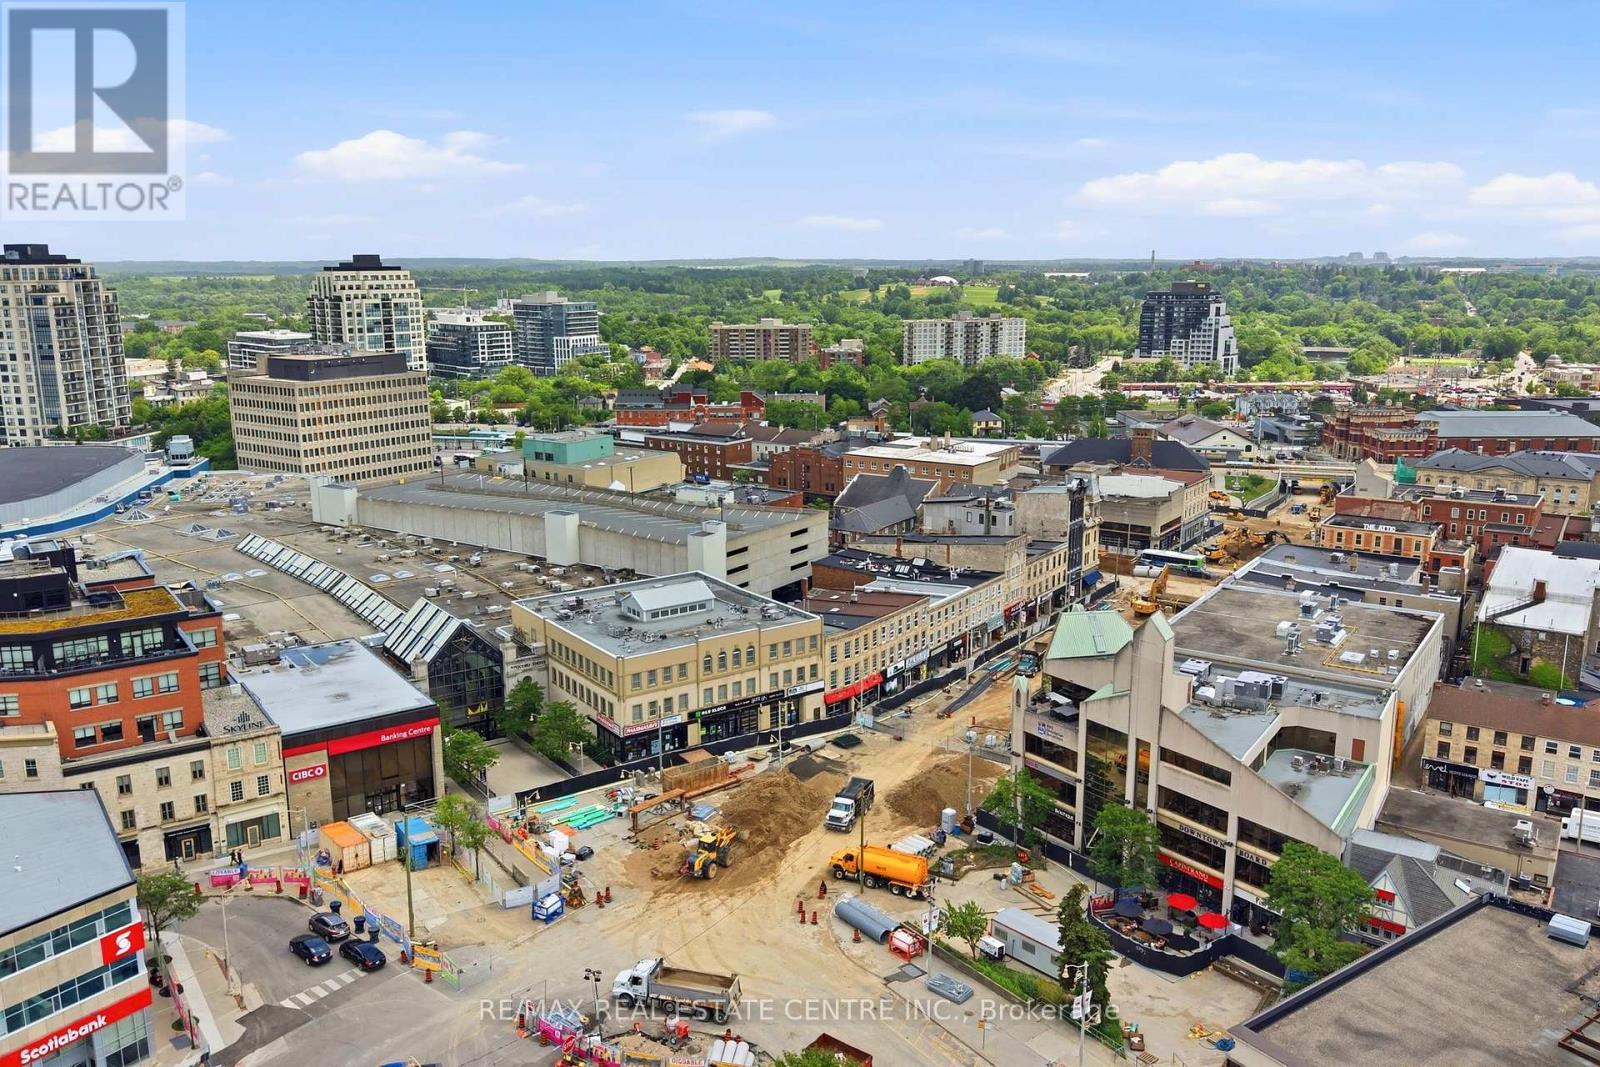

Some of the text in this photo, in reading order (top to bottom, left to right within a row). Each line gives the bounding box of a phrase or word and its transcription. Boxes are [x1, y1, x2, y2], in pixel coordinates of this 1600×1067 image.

[223, 720, 265, 734] SKYLINE
[380, 725, 432, 743] Banking Centre
[292, 770, 315, 781] CIBC
[1179, 824, 1268, 866] DOWNTOWN BOARD
[20, 1014, 108, 1066] Scotiabank
